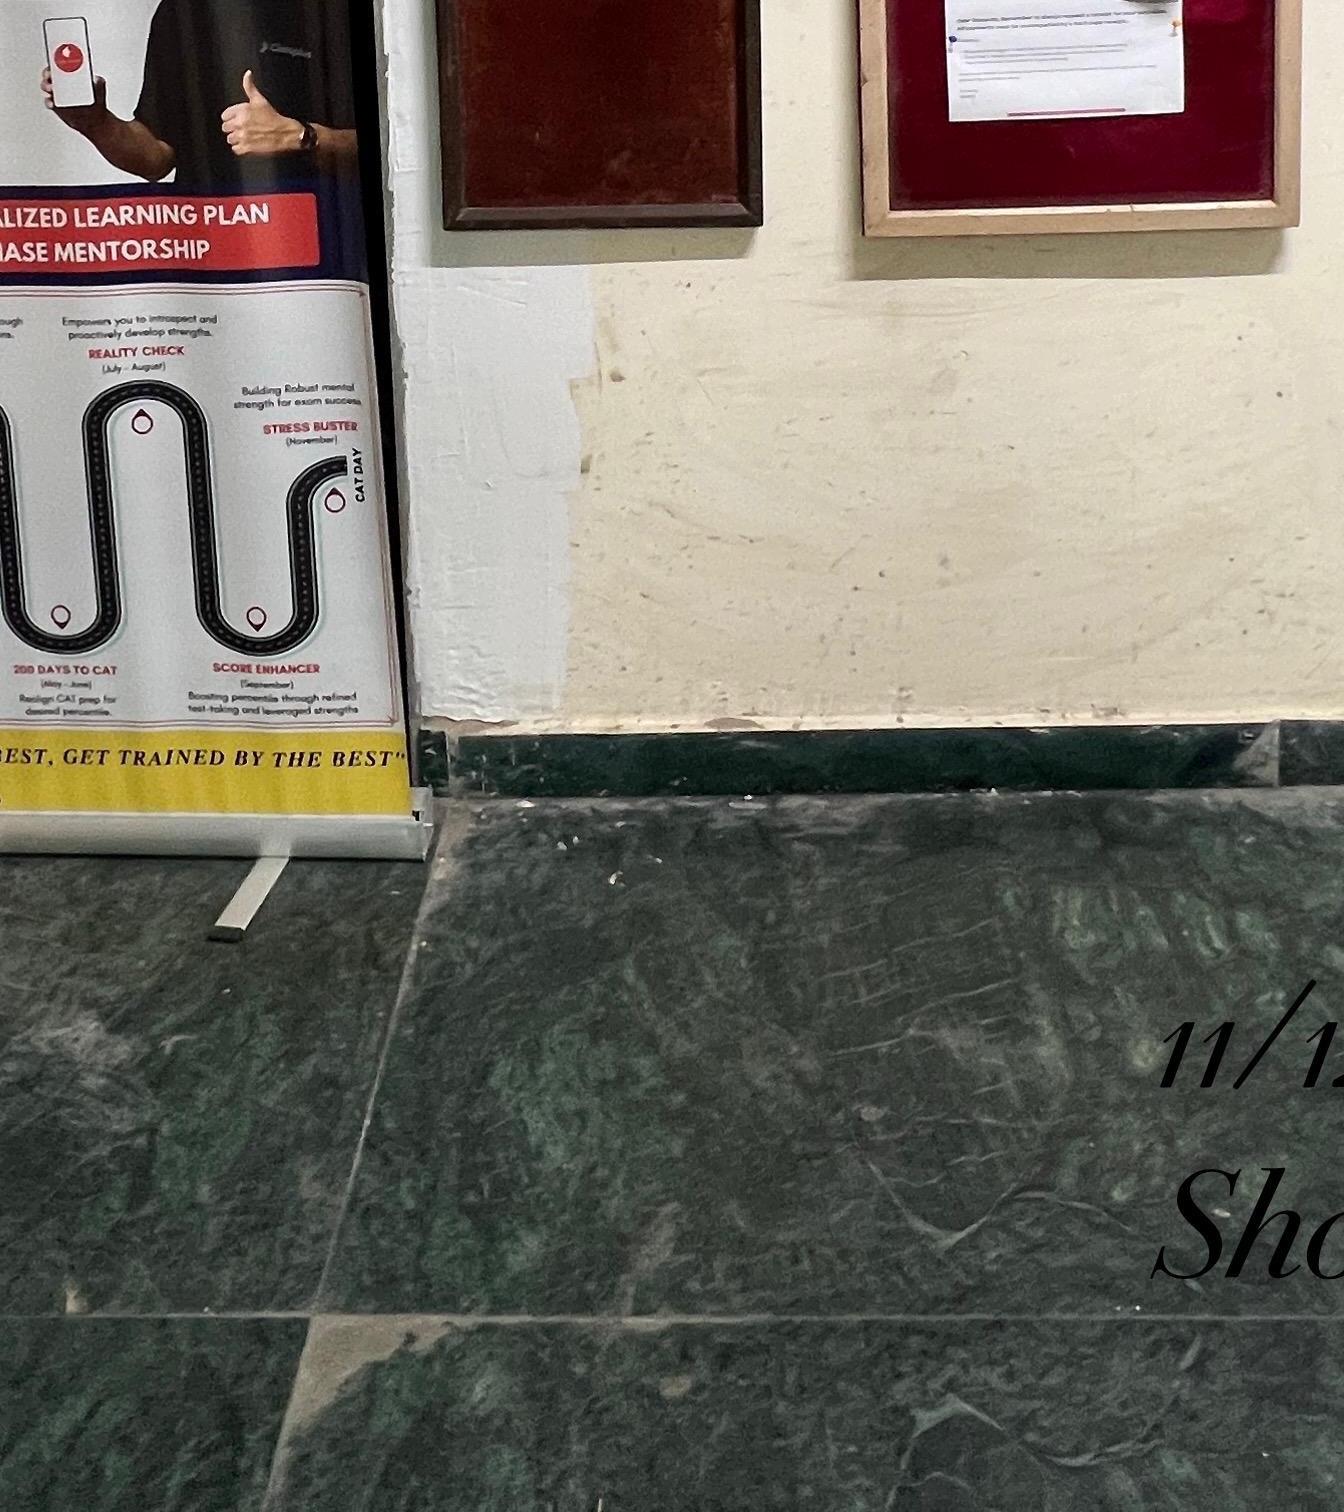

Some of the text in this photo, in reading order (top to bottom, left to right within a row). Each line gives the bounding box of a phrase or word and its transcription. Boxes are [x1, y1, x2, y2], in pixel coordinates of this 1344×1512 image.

[74, 204, 199, 229] LEARNING
[203, 203, 270, 226] PLAN
[53, 239, 211, 263] MENTORSHIP
[114, 314, 218, 328] you to and
[68, 328, 166, 341] proactively develop
[88, 345, 185, 359] REALITY CHECK
[241, 382, 356, 397] Building Robust mental
[233, 398, 323, 411] strength for exam
[263, 420, 359, 436] STRESS BUSTER
[351, 447, 366, 503] CAT DAY
[37, 664, 71, 675] DAYS
[73, 665, 90, 675] TO
[92, 665, 118, 676] CAT
[212, 662, 321, 675] SCORE ENHANCER
[56, 694, 77, 703] CAT
[78, 696, 101, 706] prep
[281, 692, 320, 705] through
[242, 705, 260, 715] and
[63, 748, 110, 766] GET
[118, 749, 225, 767] TRAINED
[234, 750, 265, 767] BY
[273, 751, 323, 768] THE
